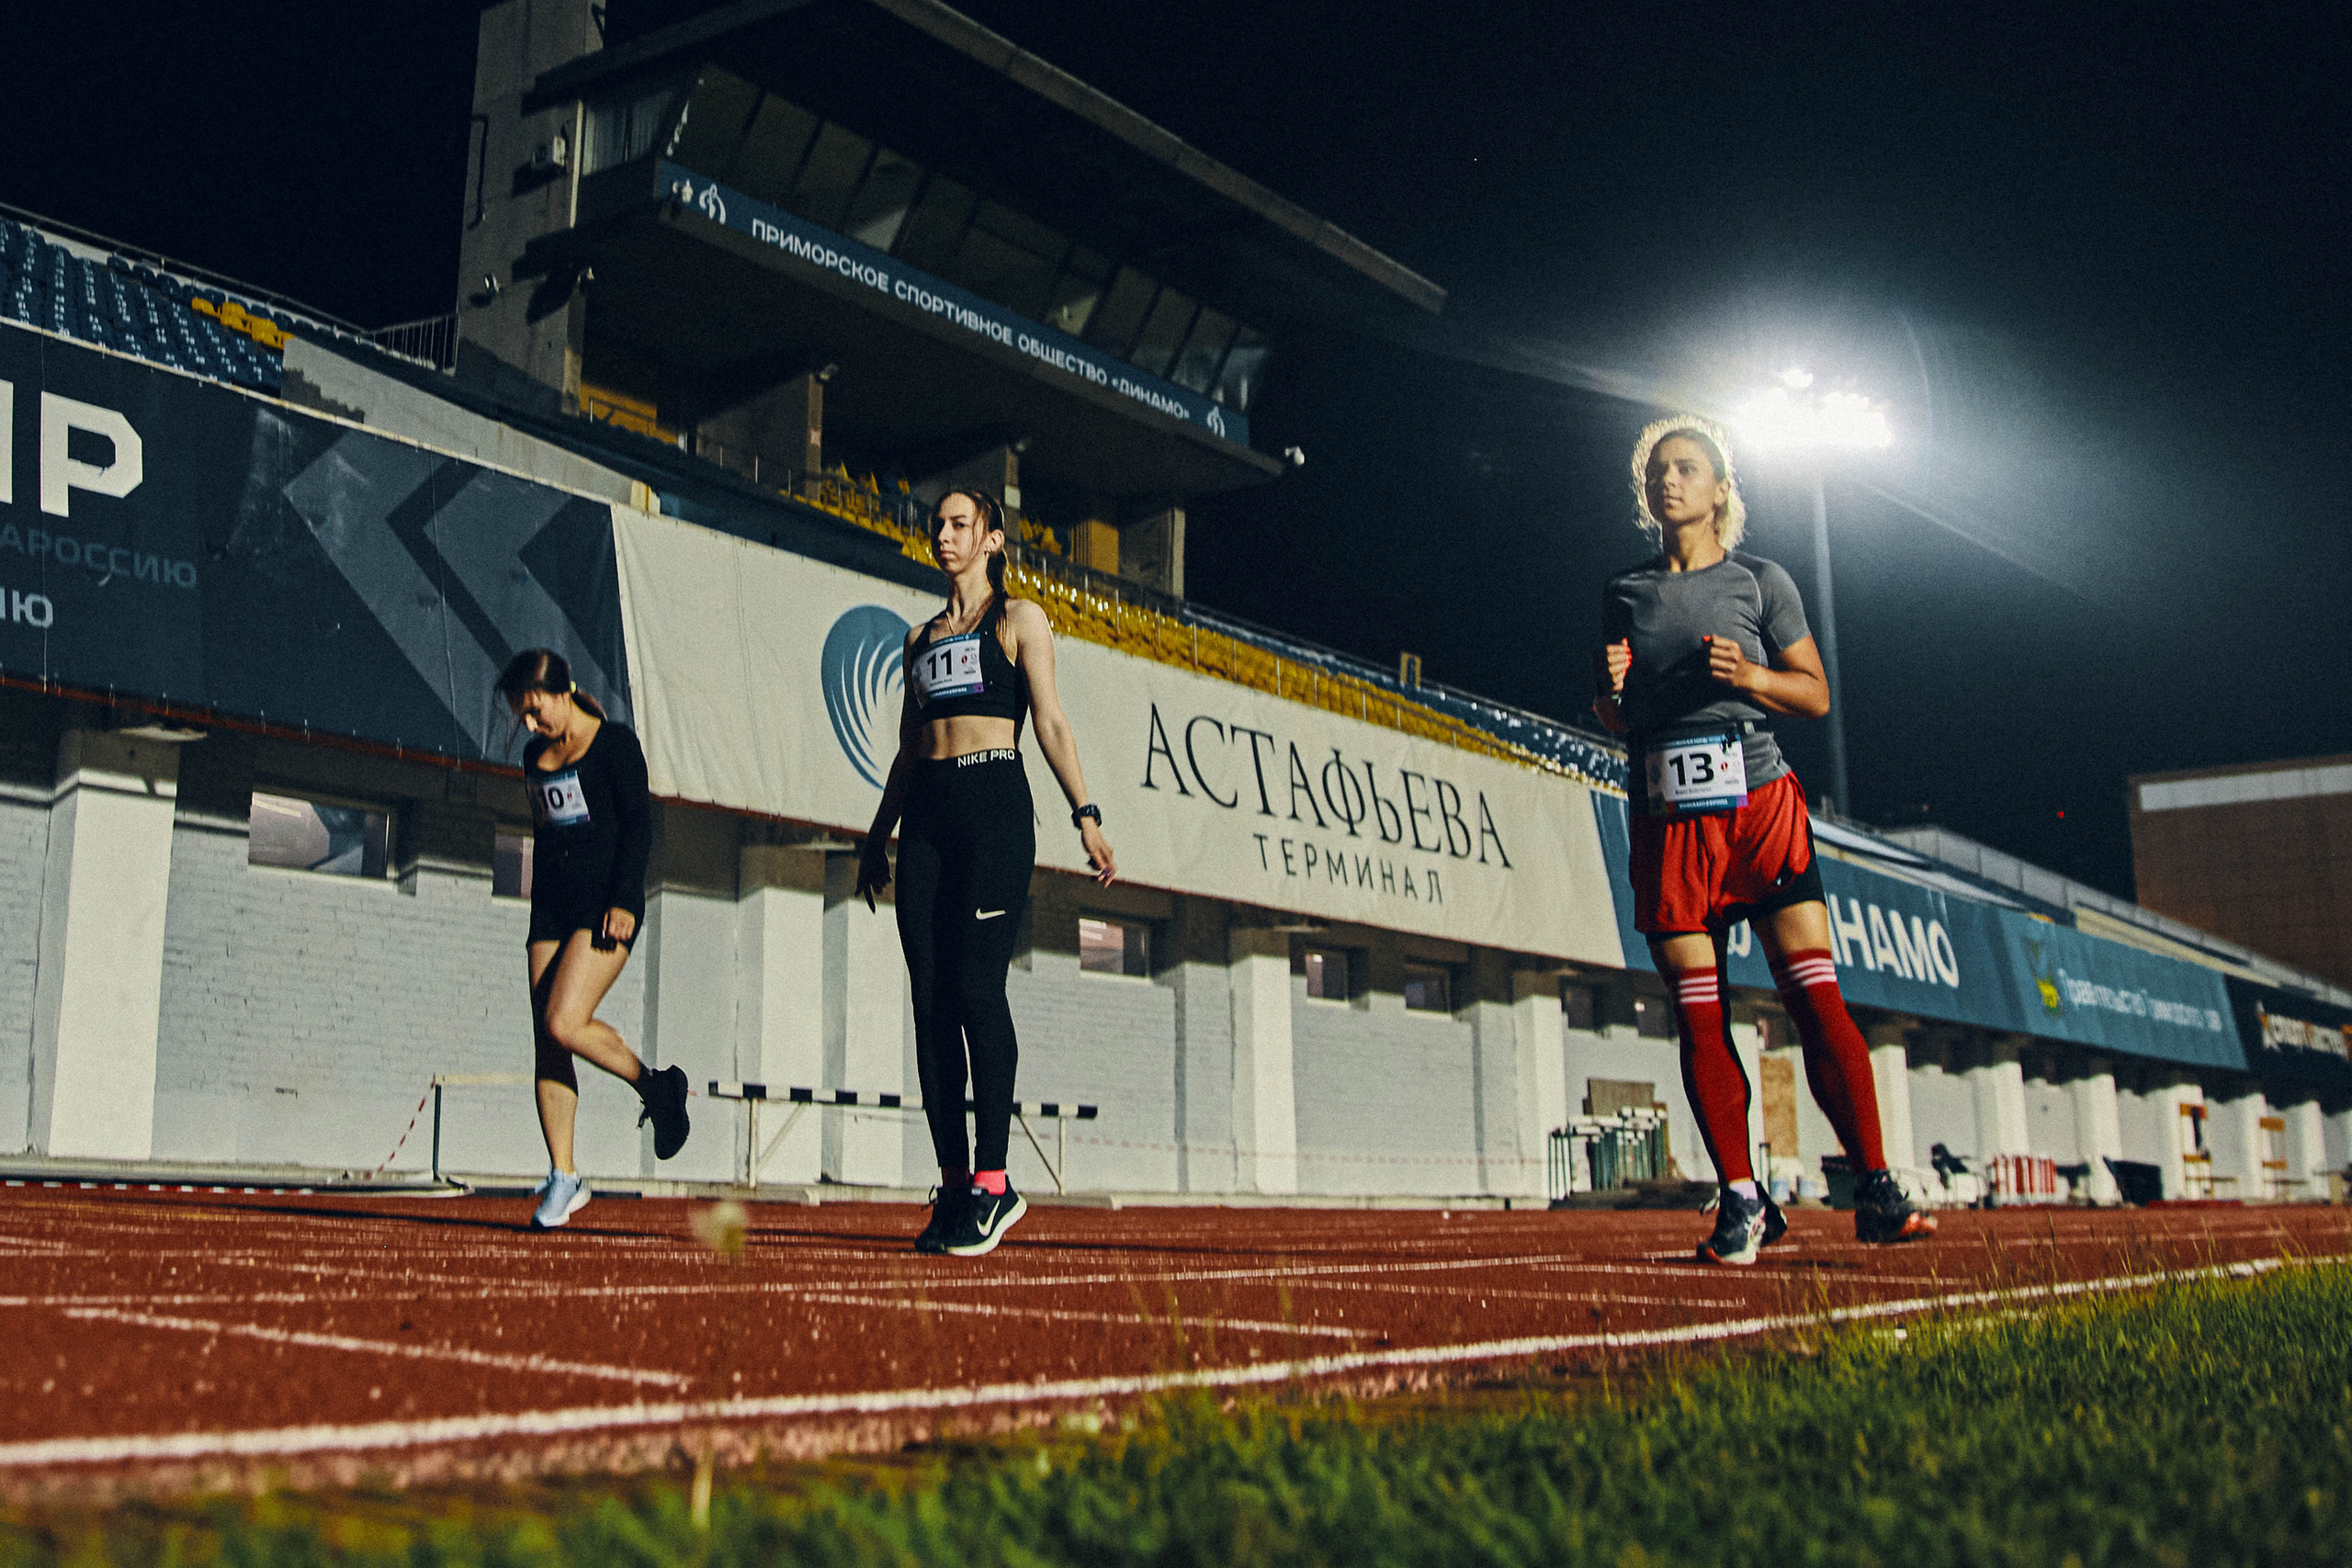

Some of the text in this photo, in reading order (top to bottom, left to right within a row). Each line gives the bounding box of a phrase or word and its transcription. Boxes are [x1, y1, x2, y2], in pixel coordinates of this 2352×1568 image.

[752, 218, 888, 293] ПРИМОРСКОЕ
[895, 279, 1012, 346] СПОРТИВНОЕ
[1018, 333, 1107, 386] ОБЩЕСТВО
[926, 649, 953, 681] 11
[957, 749, 1015, 768] NIKE PRO
[1668, 753, 1714, 786] 13
[1140, 702, 1513, 869] АСТАФЬЕВА
[1253, 833, 1442, 904] ТЕРМИНАЛ
